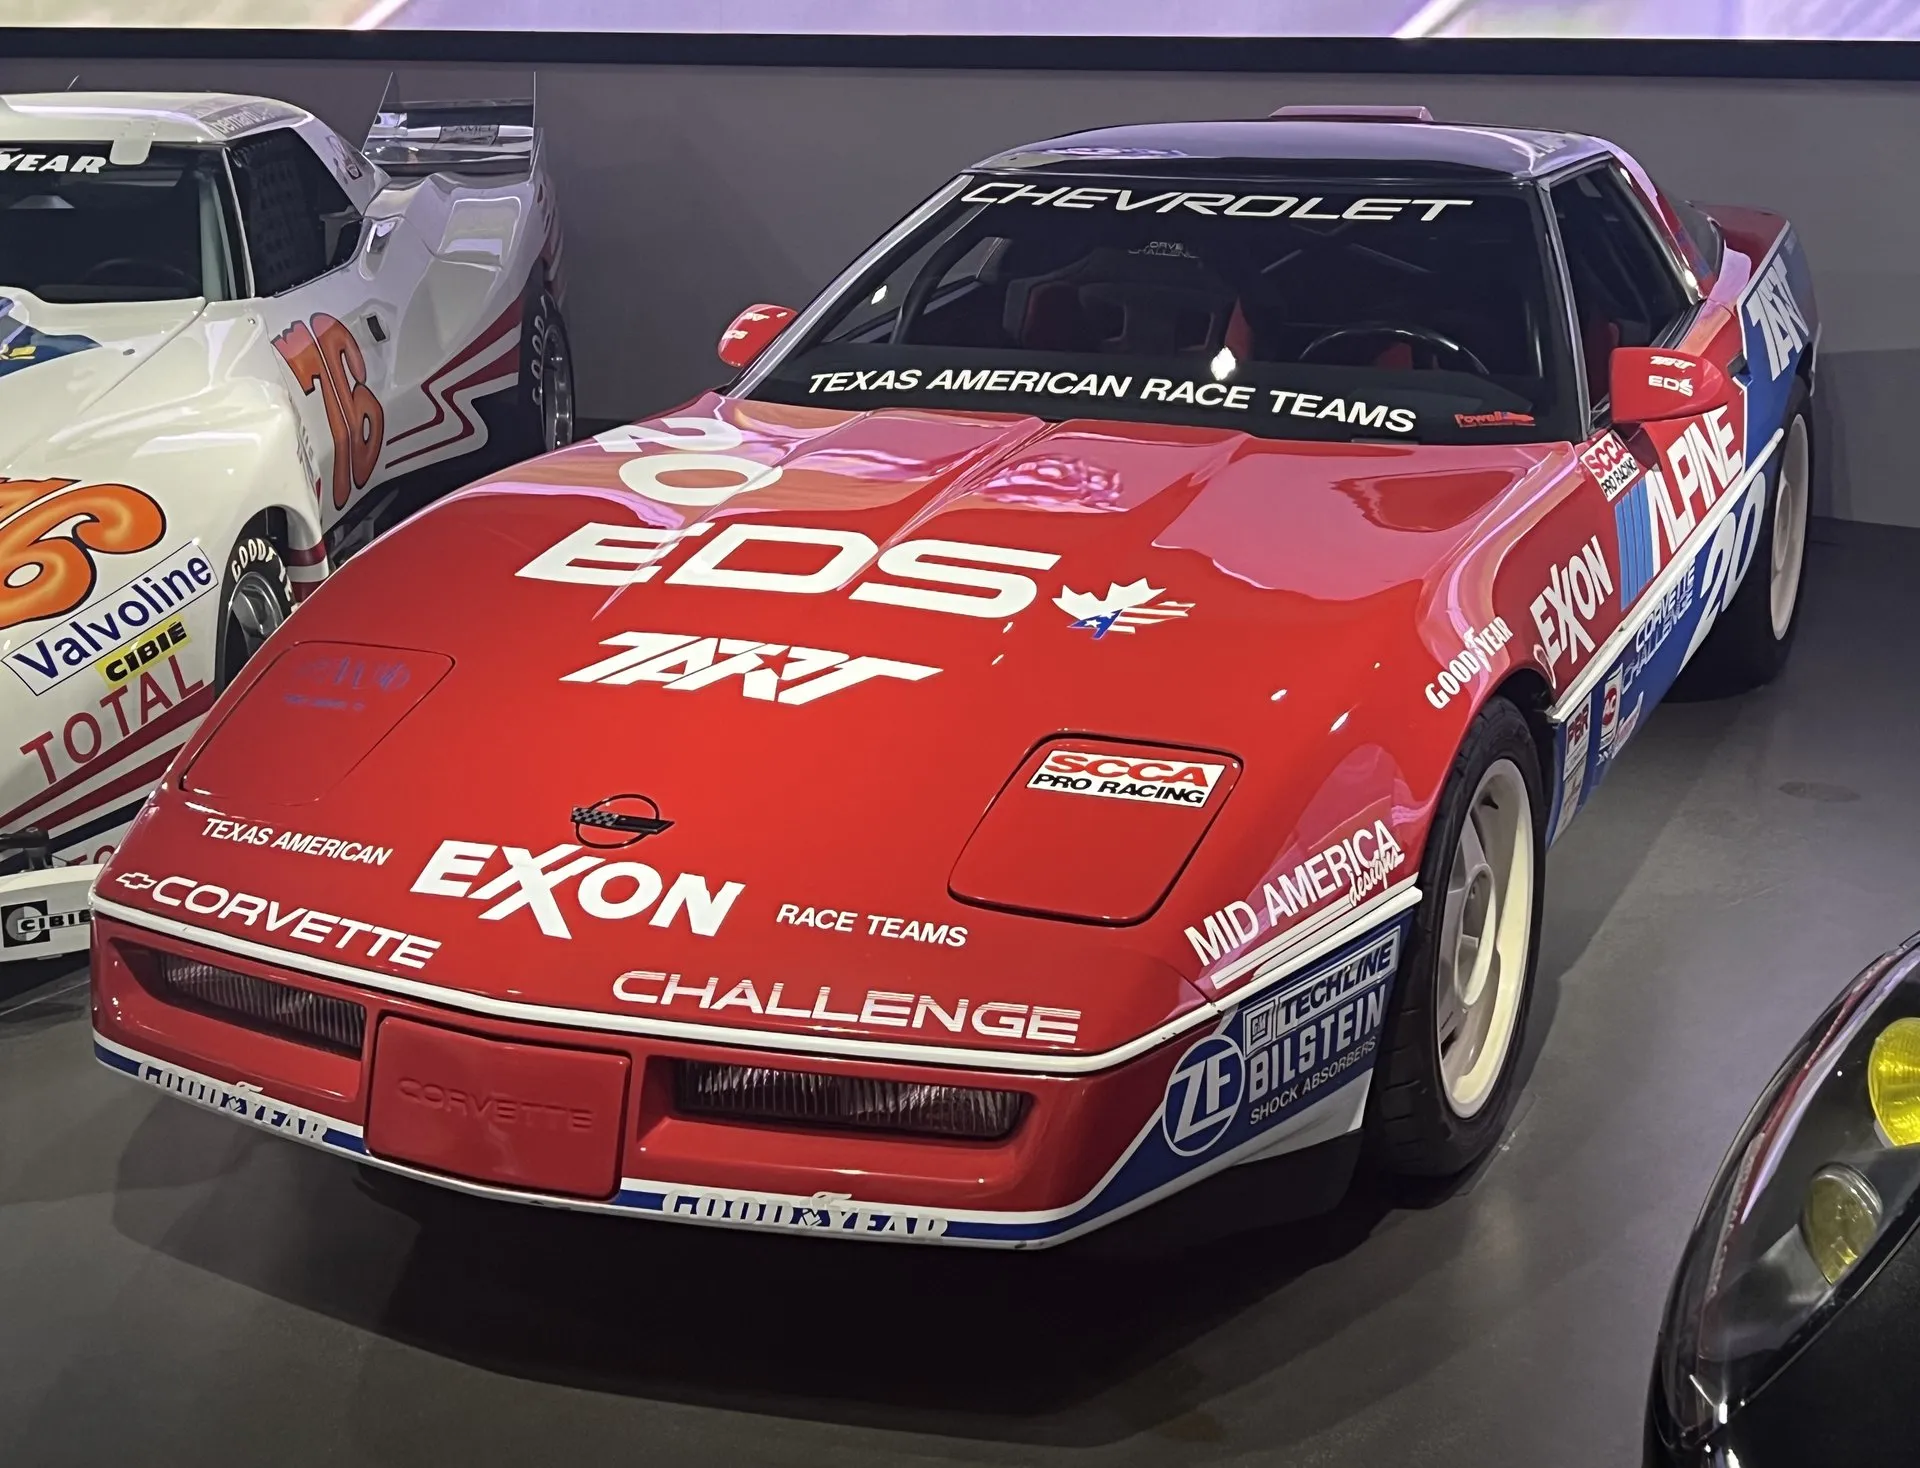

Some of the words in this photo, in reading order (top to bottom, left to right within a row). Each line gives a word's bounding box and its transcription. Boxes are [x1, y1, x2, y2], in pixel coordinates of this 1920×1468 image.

[961, 183, 1474, 223] CHEVROLET
[271, 312, 384, 510] 76
[809, 369, 918, 395] TEXAS
[926, 370, 1132, 399] AMERICAN
[1143, 379, 1254, 409] RACE
[1269, 389, 1417, 432] TEAMS
[1586, 433, 1629, 479] SCCA
[1646, 405, 1744, 576] ALPINE
[515, 522, 1061, 619] EDS
[1529, 535, 1614, 664] EXXON
[14, 558, 212, 679] Valvoline
[20, 657, 205, 785] TOTAL
[1032, 774, 1091, 792] PRO
[1099, 780, 1206, 803] RACING
[1045, 753, 1209, 787] SCCA
[202, 818, 272, 845] TEXAS
[273, 827, 393, 866] AMERICAN
[152, 876, 442, 969] CORVETTE
[411, 839, 746, 939] EXXON
[776, 904, 858, 932] RACE
[867, 914, 968, 947] TEAMS
[1184, 900, 1259, 966] MID
[1263, 819, 1402, 927] AMERICA
[612, 970, 1082, 1043] CHALLENGE
[1281, 938, 1394, 1026] TECHLINE
[1249, 984, 1386, 1103] BILSTEIN
[1250, 1084, 1299, 1125] SHOCK
[1302, 1036, 1376, 1094] ABSORBERS
[399, 1077, 595, 1132] CORVETTE
[1170, 1046, 1241, 1143] ZF
